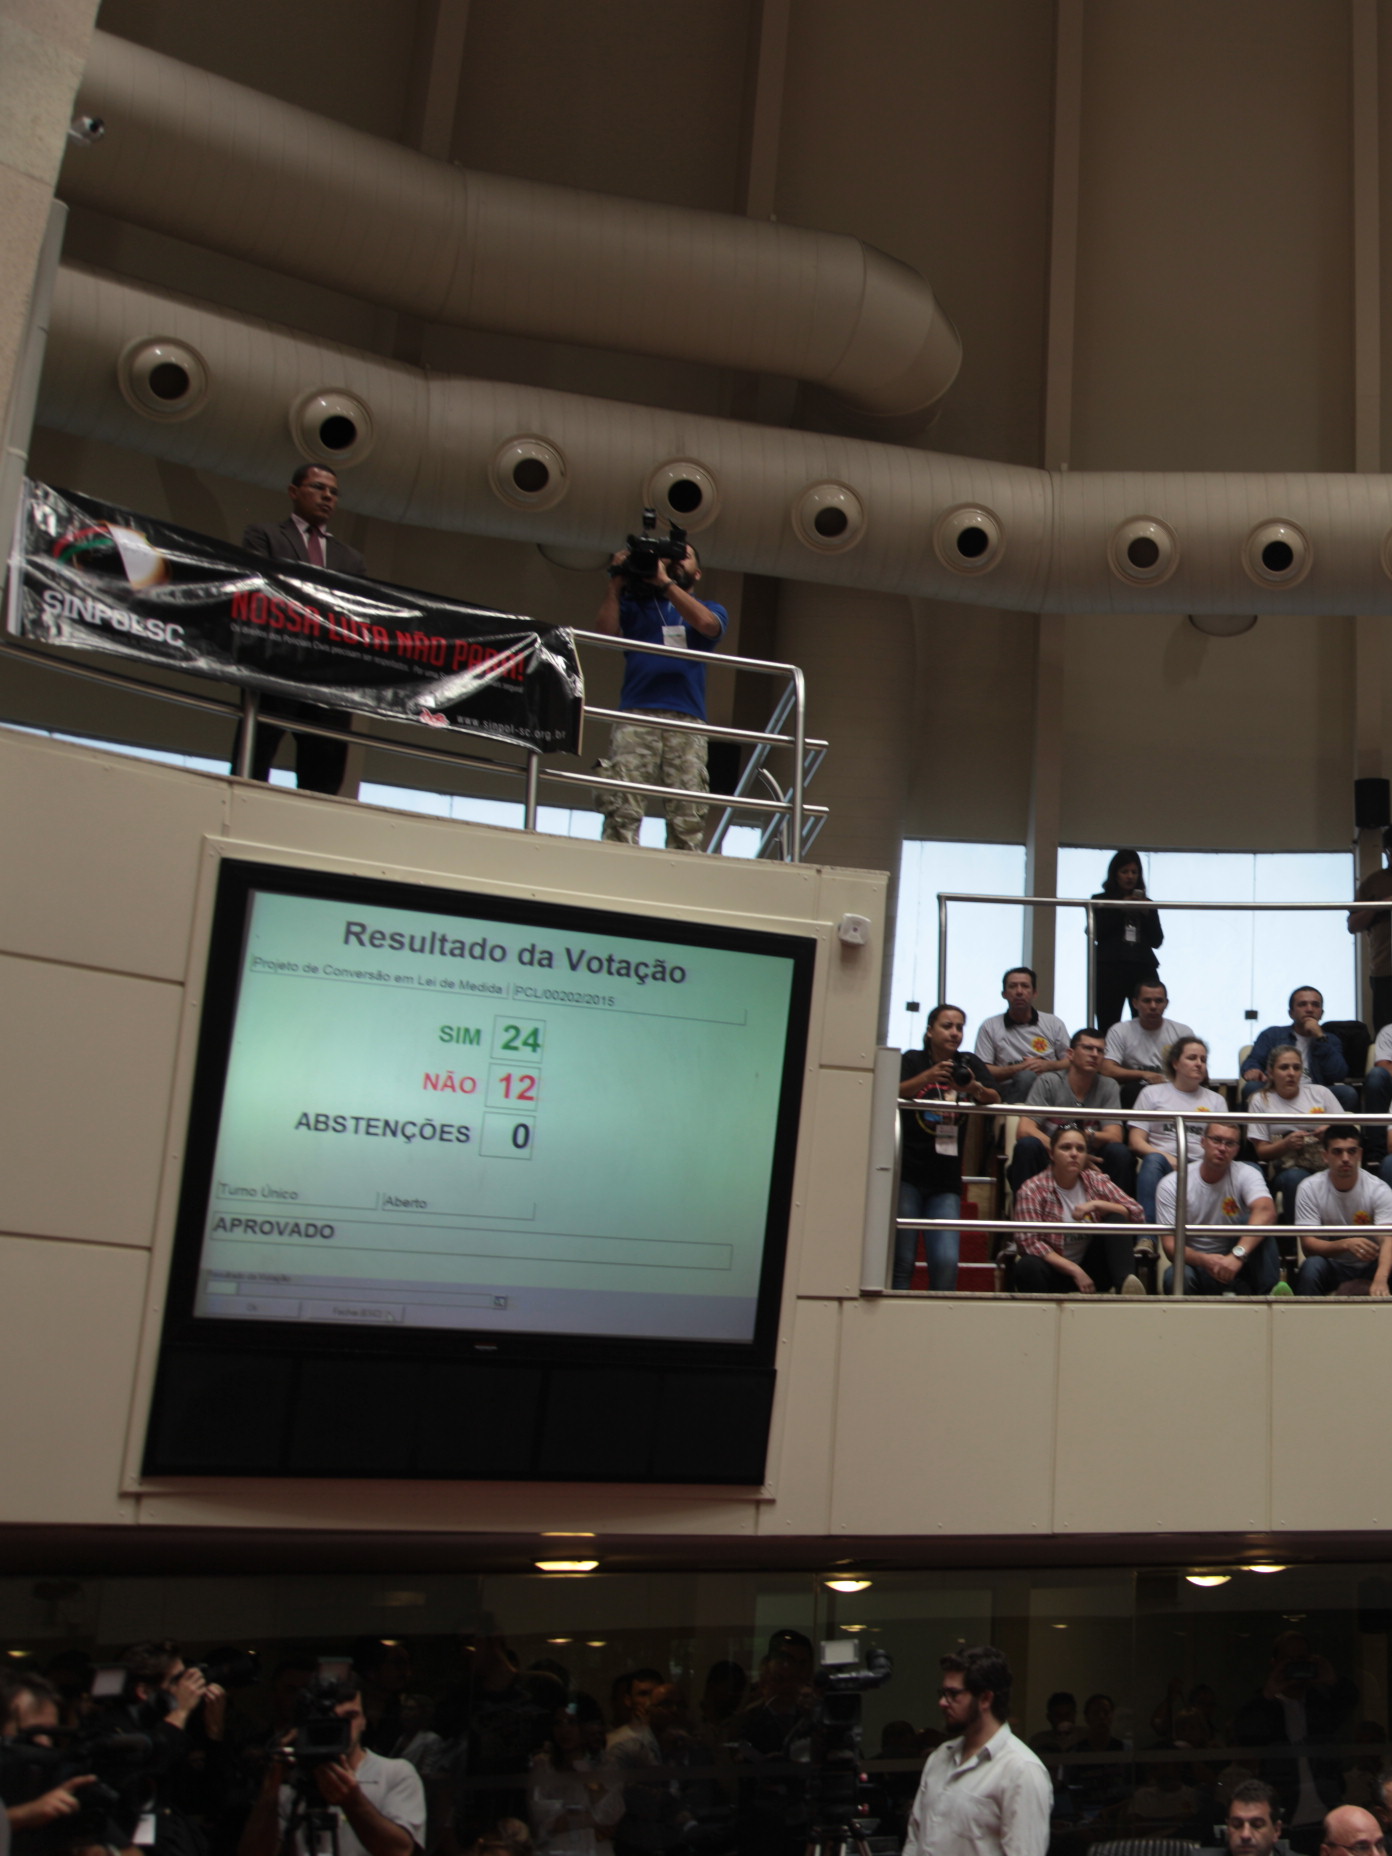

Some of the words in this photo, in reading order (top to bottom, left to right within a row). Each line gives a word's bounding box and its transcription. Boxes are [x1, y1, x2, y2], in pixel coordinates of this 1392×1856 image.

[231, 590, 320, 637] NOSSA
[328, 612, 389, 652] LUTA
[396, 630, 446, 667] NÃO
[343, 921, 507, 963] Resultado
[518, 943, 554, 970] da
[565, 947, 687, 985] Votação
[253, 957, 299, 974] Projeto
[302, 961, 319, 975] de
[323, 964, 391, 982] Conversão
[394, 974, 414, 985] em
[418, 970, 437, 987] Lei
[439, 974, 456, 989] de
[458, 979, 503, 995] Medida
[515, 986, 616, 1007] PCL/00202/2015
[438, 1025, 482, 1046] SIM
[501, 1024, 542, 1052] 24
[422, 1070, 478, 1095] NÃO
[498, 1072, 537, 1101] 12
[295, 1112, 471, 1144] ABSTENÇÕES
[512, 1123, 531, 1149] 0
[219, 1182, 257, 1198] Turno
[260, 1183, 298, 1200] Único
[384, 1194, 428, 1209] Aberto
[212, 1217, 336, 1239] APROVADO
